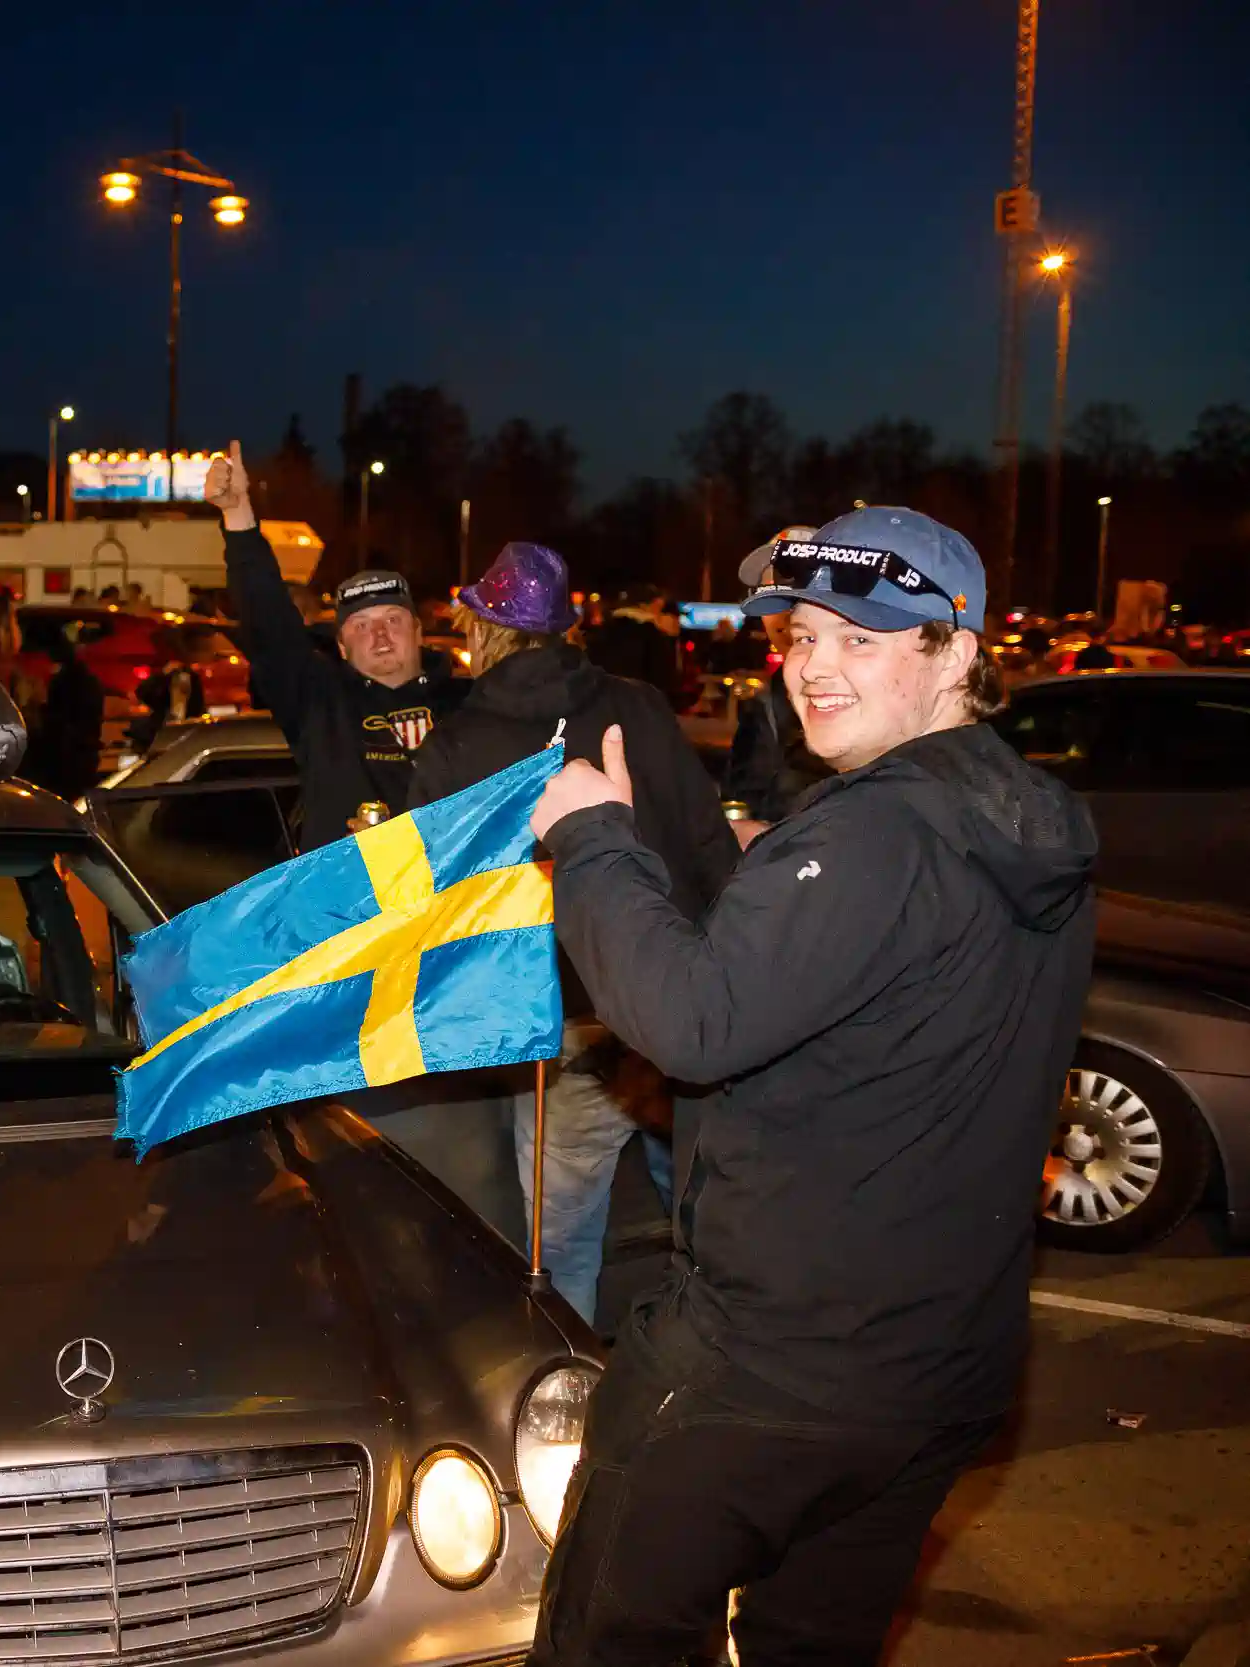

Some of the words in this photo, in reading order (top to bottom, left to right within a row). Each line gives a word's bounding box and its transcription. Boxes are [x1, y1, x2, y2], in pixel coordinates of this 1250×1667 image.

[781, 543, 818, 560] JOSP
[817, 546, 883, 567] PRODUCT
[897, 568, 921, 588] JP
